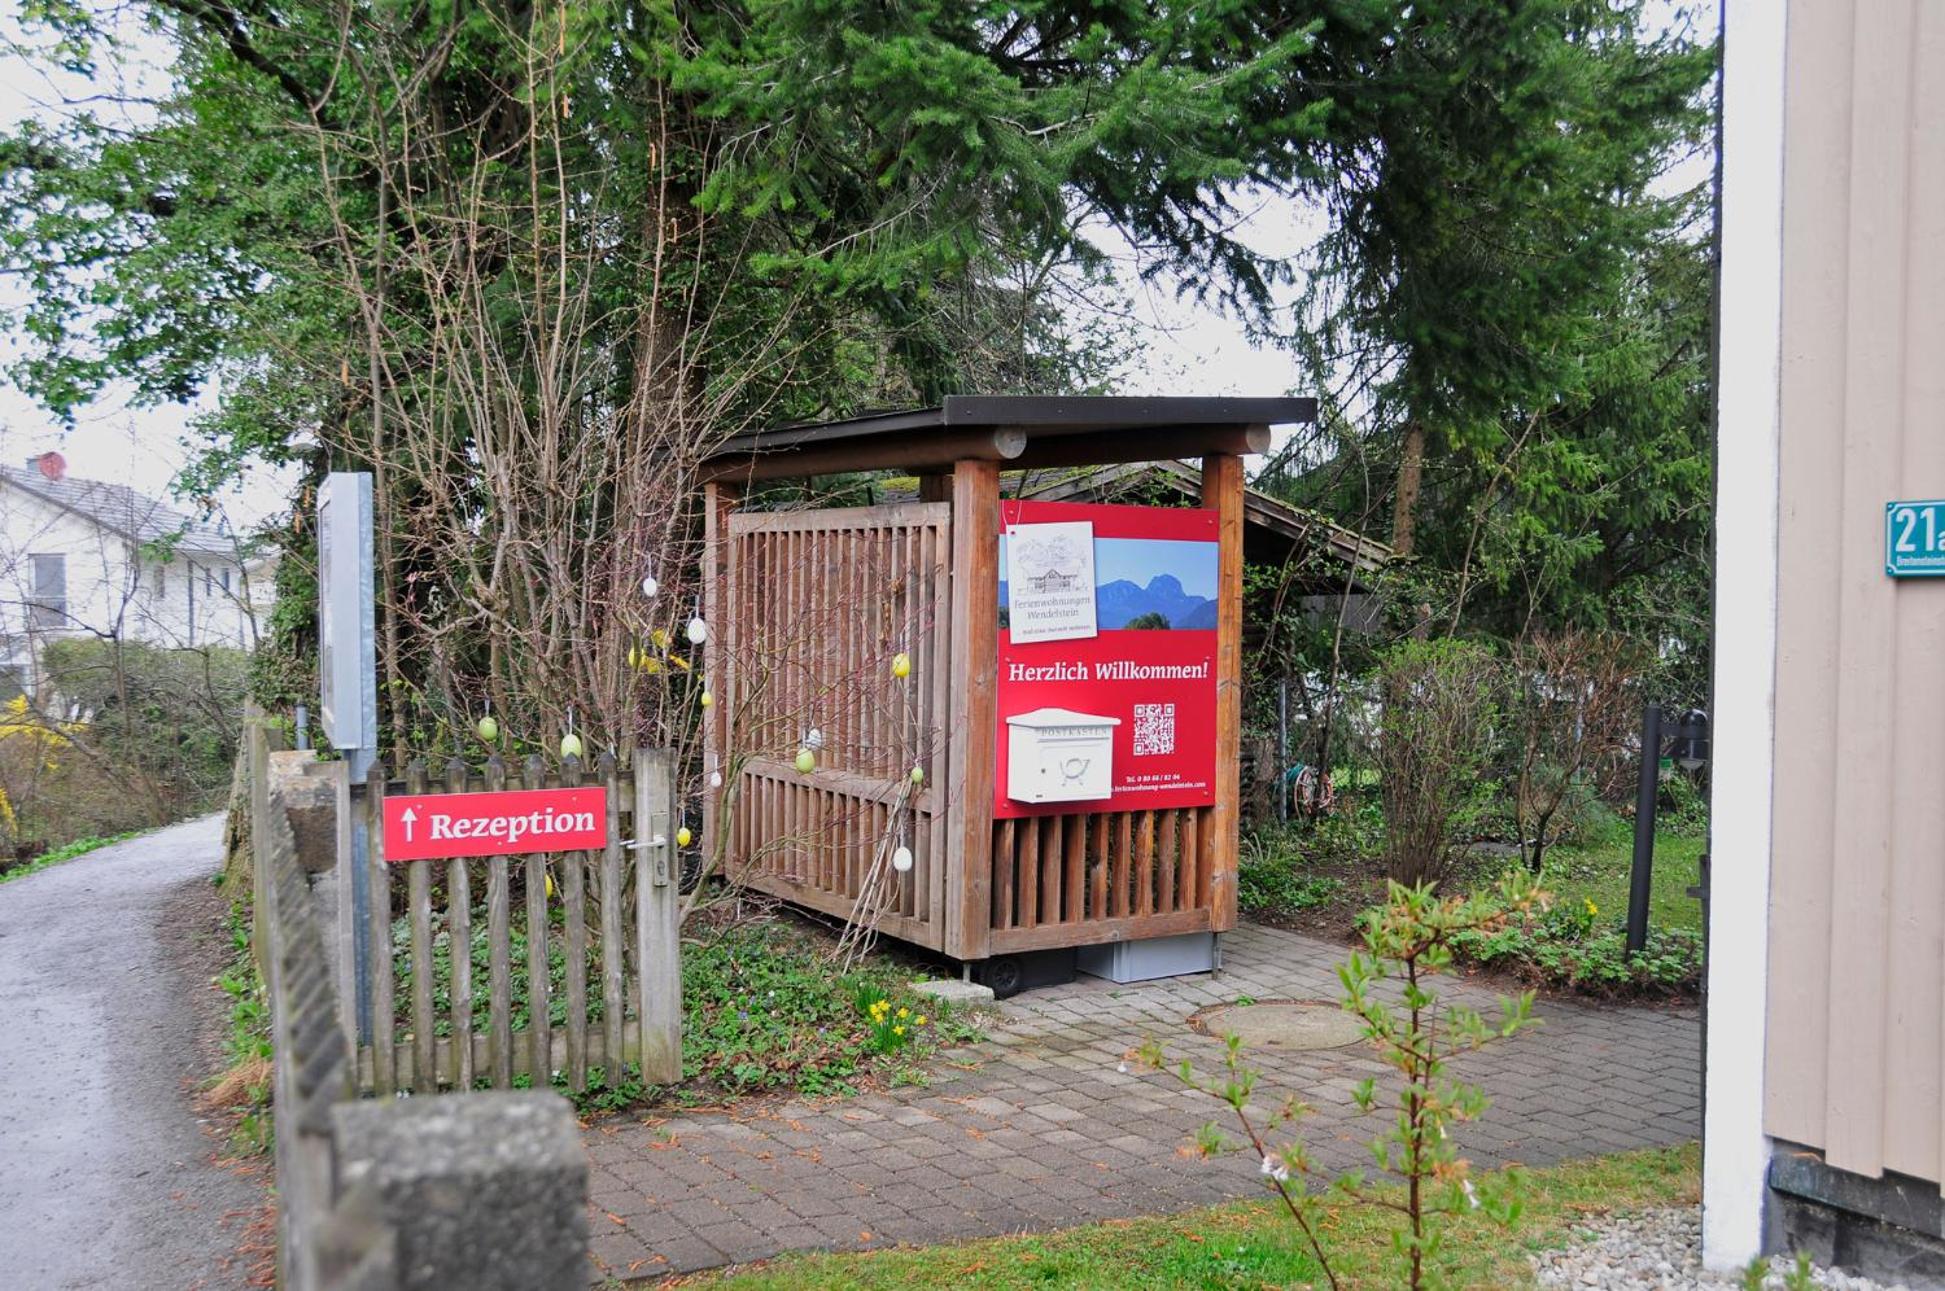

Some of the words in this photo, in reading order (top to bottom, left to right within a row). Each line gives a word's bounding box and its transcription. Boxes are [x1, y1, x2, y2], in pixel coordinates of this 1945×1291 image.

[1014, 596, 1091, 609] Ferienwohnungen
[1027, 608, 1080, 620] Wendelstein
[1008, 661, 1089, 682] Herzlich
[1095, 660, 1208, 680] Willkommen!
[429, 807, 596, 843] Rezeption
